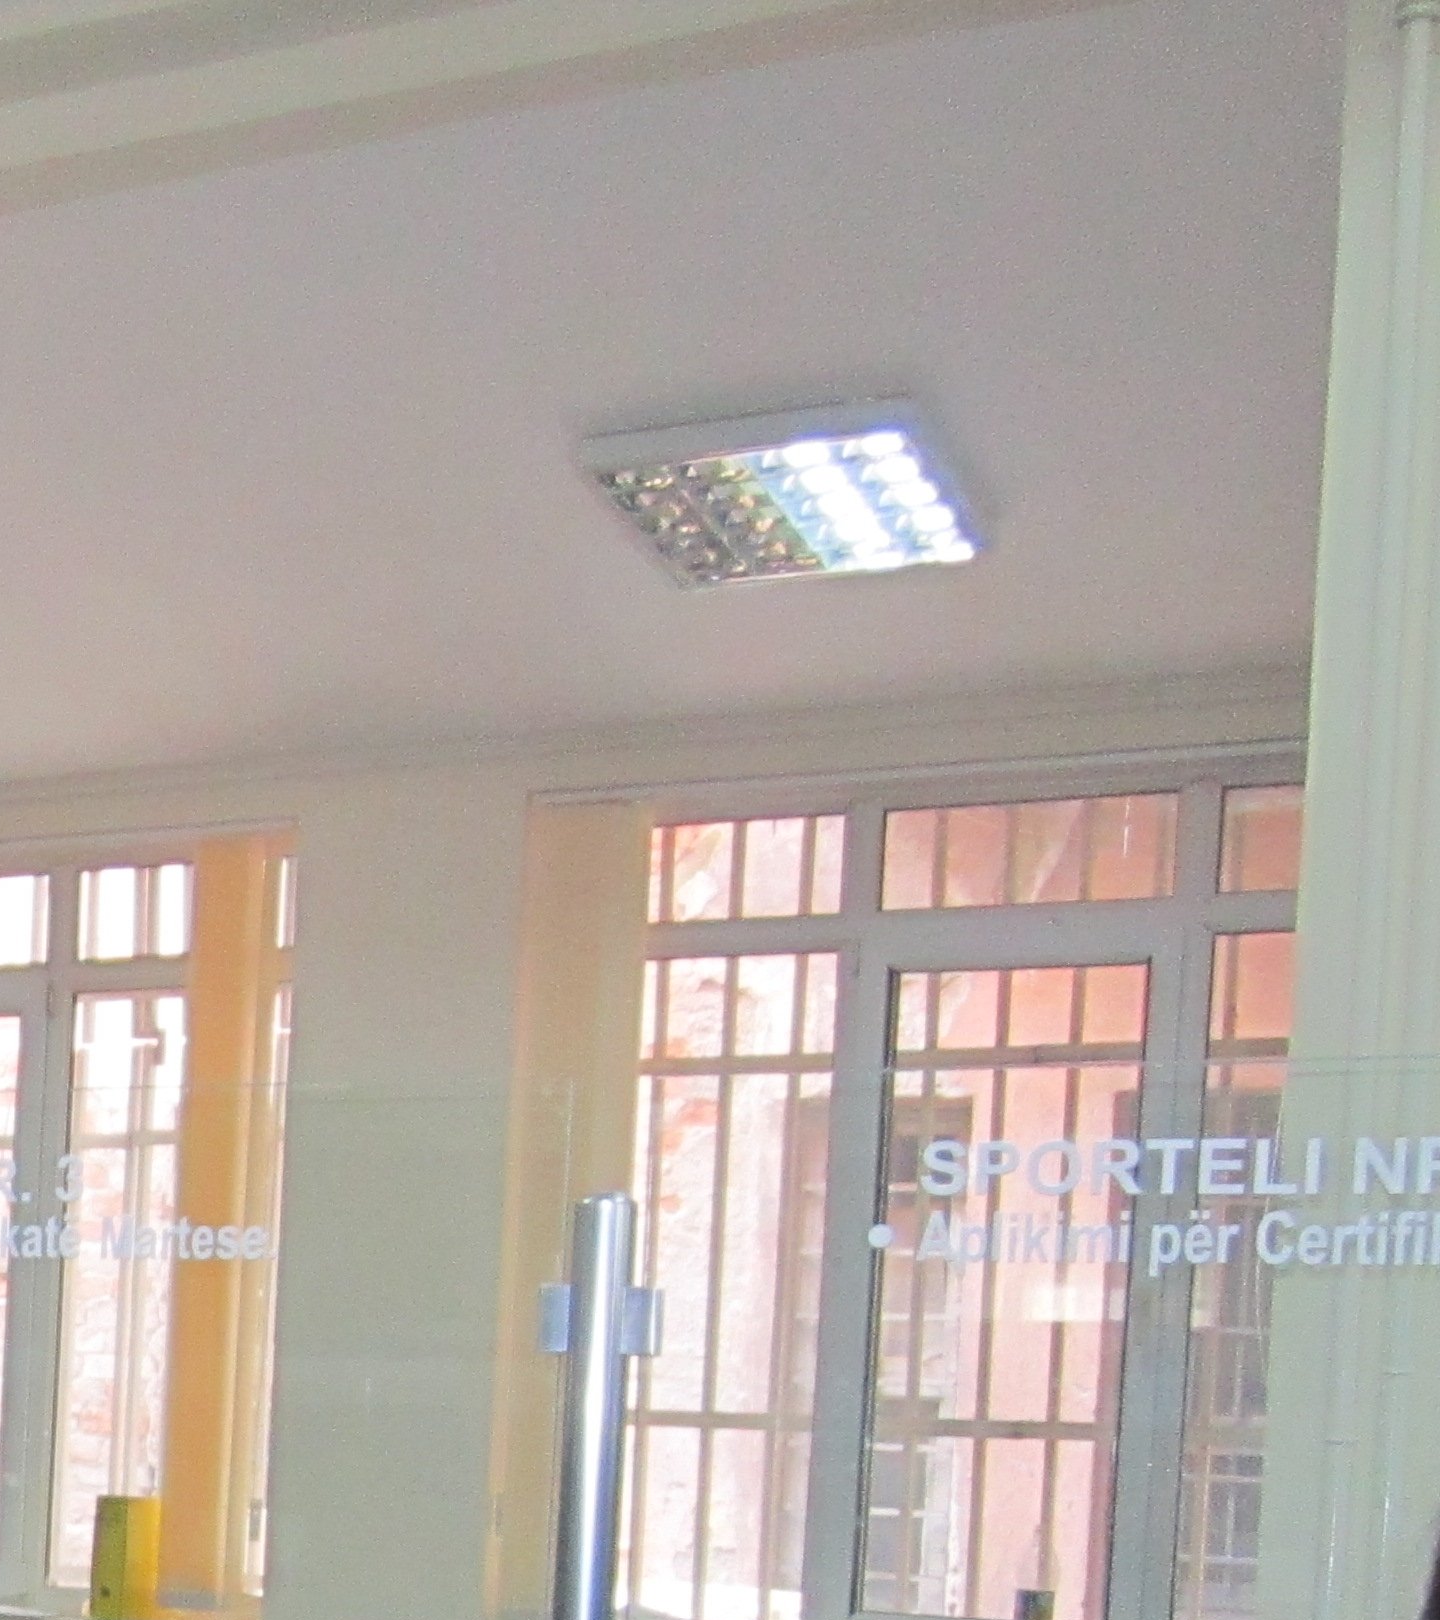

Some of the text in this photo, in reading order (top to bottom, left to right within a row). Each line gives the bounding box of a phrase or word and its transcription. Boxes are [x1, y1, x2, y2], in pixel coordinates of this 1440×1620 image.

[54, 1154, 84, 1203] 3
[920, 1136, 1322, 1196] SPORTELI
[99, 1216, 276, 1262] Martese.
[916, 1209, 1132, 1272] Aplikimi
[1146, 1209, 1241, 1277] për
